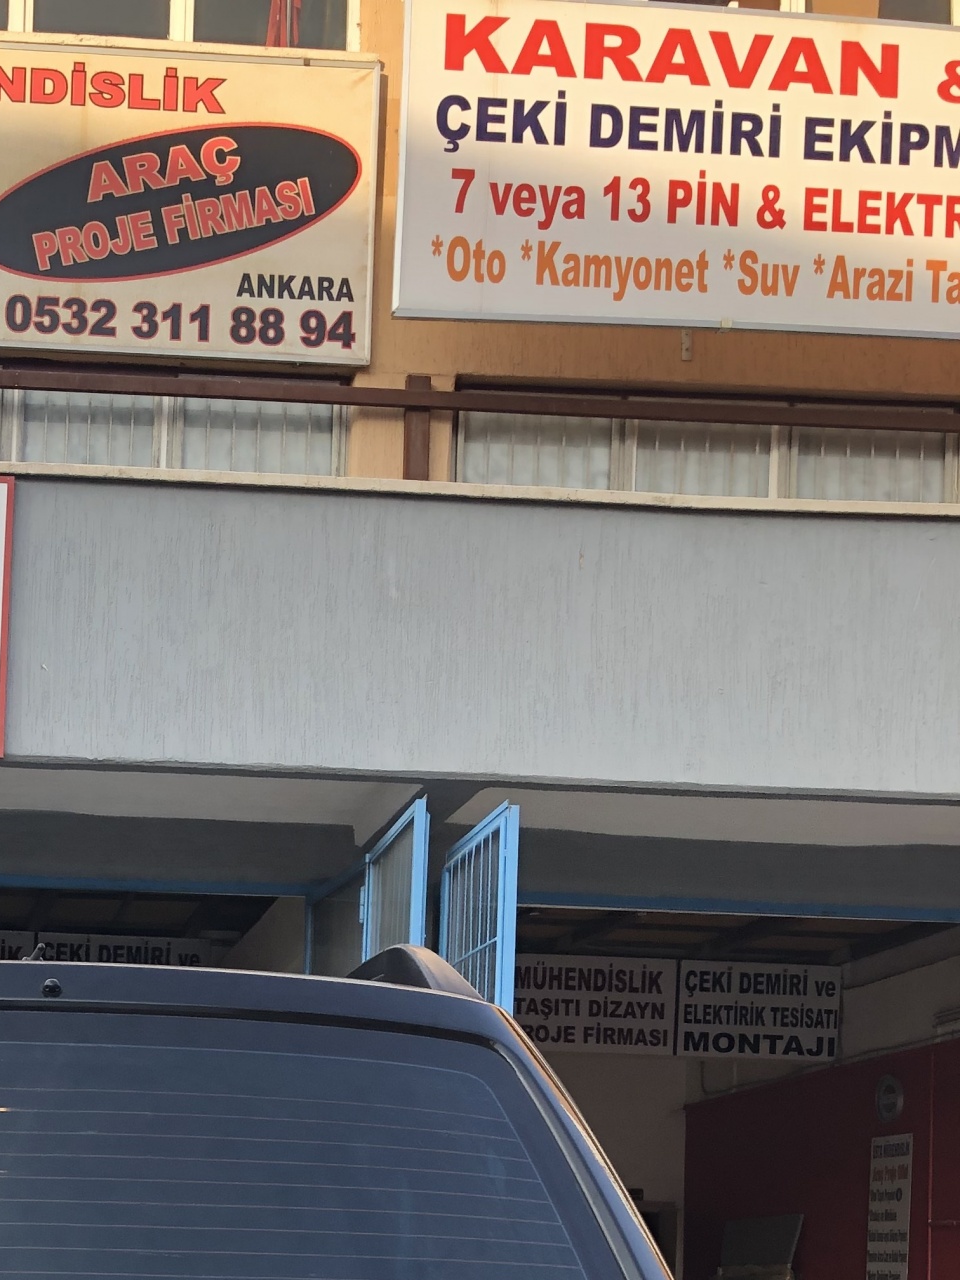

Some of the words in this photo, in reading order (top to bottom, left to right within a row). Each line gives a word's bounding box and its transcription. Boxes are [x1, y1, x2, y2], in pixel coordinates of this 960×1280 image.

[443, 13, 900, 99] KARAVAN
[436, 90, 567, 153] ÇEKİ
[589, 99, 782, 158] DEMİRİ
[86, 136, 241, 203] ARAÇ
[451, 168, 476, 213] 7
[489, 178, 586, 230] veya
[602, 176, 651, 223] 13
[667, 169, 739, 227] PİN
[757, 184, 786, 230] &
[32, 211, 160, 271] PROJE
[160, 177, 315, 244] FİRMASI
[237, 273, 355, 302] ANKARA
[5, 293, 117, 338] 0532
[131, 301, 211, 342] 311
[229, 305, 285, 346] 88
[299, 308, 356, 349] 94
[515, 961, 664, 994] MÜHENDİSLİK
[684, 966, 733, 997] ÇEKİ
[739, 968, 808, 996] DEMİRİ
[815, 980, 836, 997] ve
[514, 998, 580, 1020] TAŞITI
[588, 996, 665, 1020] DİZAYN
[683, 1000, 766, 1026] ELEKTİRİK
[770, 1003, 838, 1029] TESİSATI
[520, 1025, 575, 1043] ROJE
[583, 1022, 668, 1047] FİRMASI
[683, 1031, 836, 1057] MONTAJI
